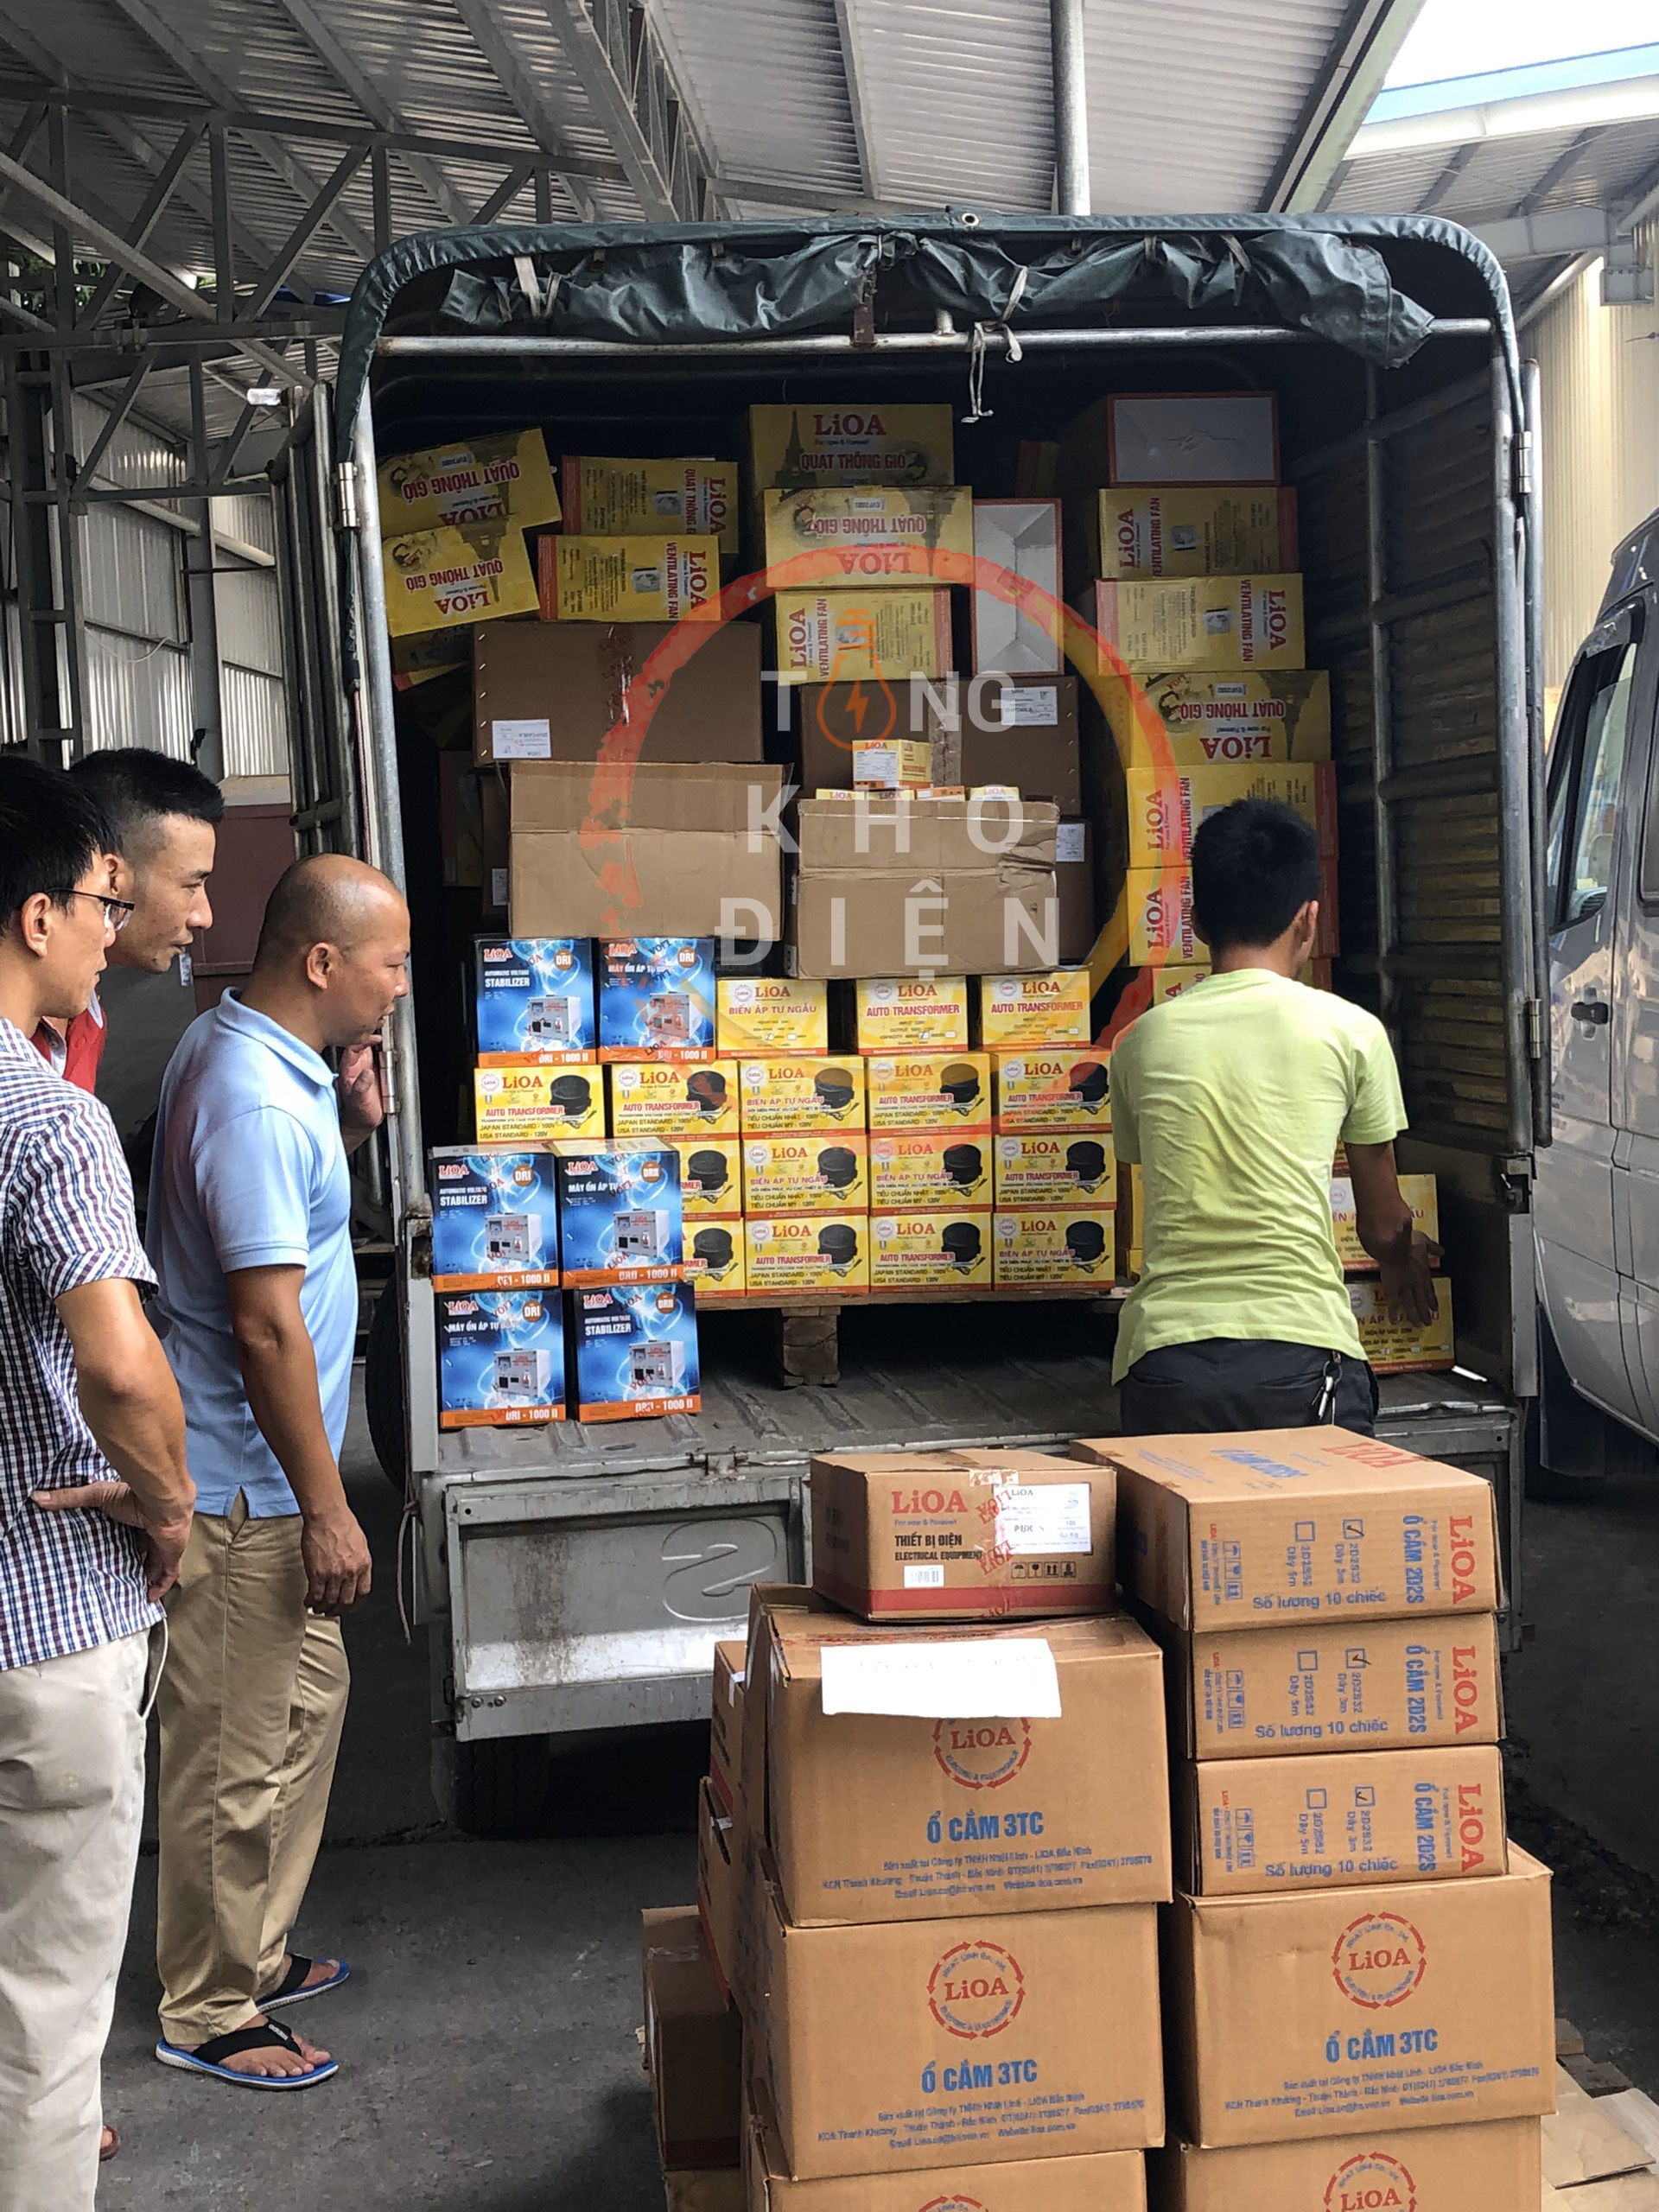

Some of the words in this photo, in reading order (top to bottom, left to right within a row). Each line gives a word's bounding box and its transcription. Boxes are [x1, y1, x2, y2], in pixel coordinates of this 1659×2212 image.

[813, 415, 886, 435] LiOA
[432, 468, 481, 495] THÔNG
[709, 478, 727, 535] LiOA
[1150, 498, 1161, 517] FAN
[1118, 509, 1135, 569] LiOA
[666, 542, 679, 597] VENTILATING
[836, 552, 912, 575] LiOA
[429, 563, 468, 588] THÔNG
[690, 550, 709, 610] LiOA
[435, 589, 490, 615] LiOA
[668, 598, 679, 620] FAN
[817, 598, 828, 617] FAN
[1240, 579, 1253, 638] VENTILATING
[1268, 589, 1287, 651] LiOA
[788, 607, 806, 669] LiOA
[1242, 639, 1253, 663] FAN
[1205, 701, 1249, 724] THÔNG
[1199, 735, 1271, 760] LiOA
[1179, 777, 1191, 797] FAN
[1146, 788, 1163, 852] LiOA
[1146, 887, 1163, 950] LiOA
[485, 976, 530, 988] STABILIZER
[898, 984, 938, 997] LiOA
[1022, 981, 1061, 994] LiOA
[755, 986, 791, 998] LiOA
[754, 1003, 768, 1014] ÁP
[867, 1005, 890, 1017] AUTO
[893, 1004, 960, 1016] TRANSFORMER
[991, 1002, 1014, 1014] AUTO
[1017, 1001, 1084, 1013] TRANSFORMER
[639, 1071, 681, 1084] LiOA
[768, 1067, 804, 1079] LiOA
[894, 1065, 933, 1077] LiOA
[1023, 1063, 1064, 1076] LiOA
[502, 1076, 543, 1089] LiOA
[486, 1108, 505, 1116] AUTO
[507, 1106, 564, 1116] TRANSFORMER
[623, 1103, 642, 1112] AUTO
[645, 1102, 701, 1111] TRANSFORMER
[772, 1147, 808, 1159] LiOA
[898, 1142, 933, 1155] LiOA
[1021, 1141, 1060, 1154] LiOA
[1005, 1173, 1024, 1181] AUTO
[1026, 1171, 1079, 1180] TRANSFORMER
[440, 1194, 488, 1206] STABILIZER
[772, 1225, 812, 1237] LiOA
[896, 1222, 936, 1236] LiOA
[1020, 1220, 1057, 1232] LiOA
[756, 1256, 774, 1265] AUTO
[777, 1255, 832, 1264] TRANSFORMER
[880, 1254, 898, 1262] AUTO
[901, 1252, 955, 1262] TRANSFORMER
[585, 1323, 632, 1336] STABILIZER
[891, 1490, 968, 1514] LiOA
[1011, 1488, 1034, 1497] LiOA
[893, 1533, 923, 1548] THIẾT
[925, 1535, 936, 1549] BỊ
[938, 1533, 963, 1548] ĐIỆN
[893, 1551, 938, 1561] ELECTRICAL
[1449, 1515, 1477, 1605] LiOA
[1252, 1592, 1274, 1610] Số
[1325, 1592, 1343, 1606] 10
[1452, 1645, 1478, 1735] LiOA
[950, 1726, 1016, 1751] LiOA
[1255, 1721, 1276, 1739] Số
[1327, 1721, 1345, 1735] 10
[926, 1810, 943, 1844] Ổ
[1004, 1811, 1045, 1838] 3TC
[1457, 1783, 1485, 1872] LiOA
[1264, 1860, 1286, 1878] Số
[1338, 1859, 1355, 1873] 10
[1348, 1948, 1411, 1973] LiOA
[944, 1976, 1009, 2002] LiOA
[1325, 2030, 1342, 2064] Ổ
[1399, 2028, 1439, 2056] 3TC
[921, 2060, 937, 2094] Ổ
[998, 2059, 1039, 2086] 3TC
[1340, 2187, 1402, 2212] LiOA
